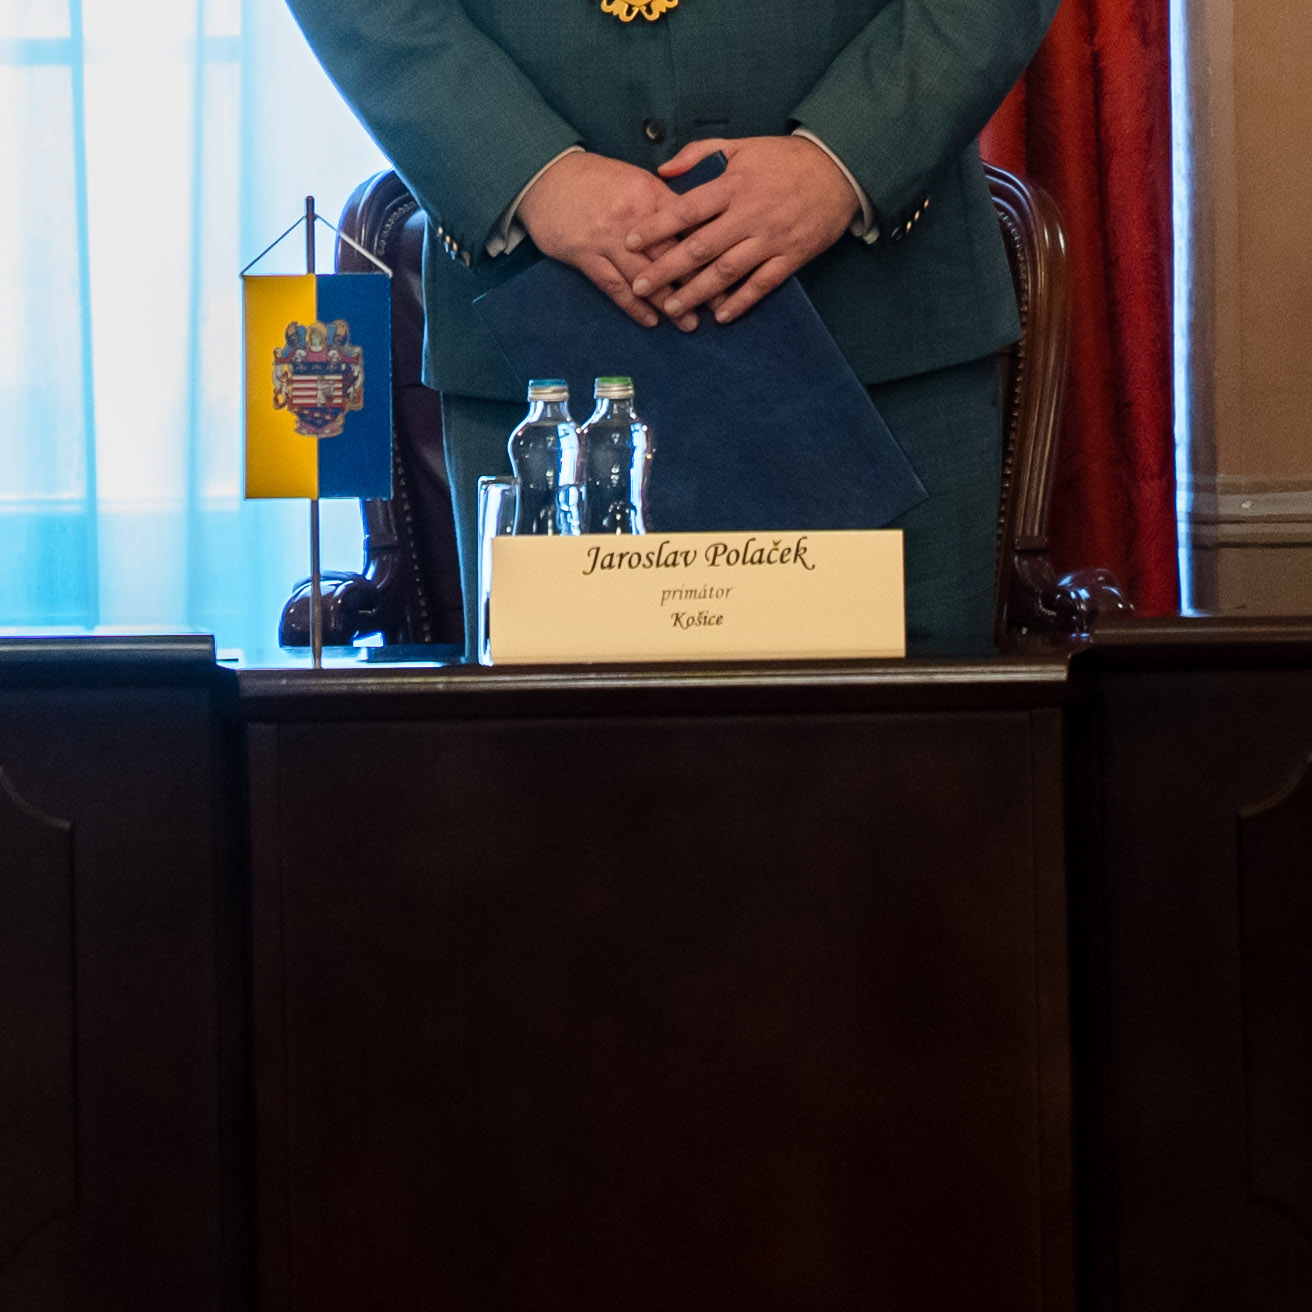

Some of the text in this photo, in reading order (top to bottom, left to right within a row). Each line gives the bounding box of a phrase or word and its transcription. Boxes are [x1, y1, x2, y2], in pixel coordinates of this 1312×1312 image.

[582, 536, 815, 576] Jaroslav Polaček
[660, 584, 733, 606] primátor
[670, 610, 724, 629] Košice
